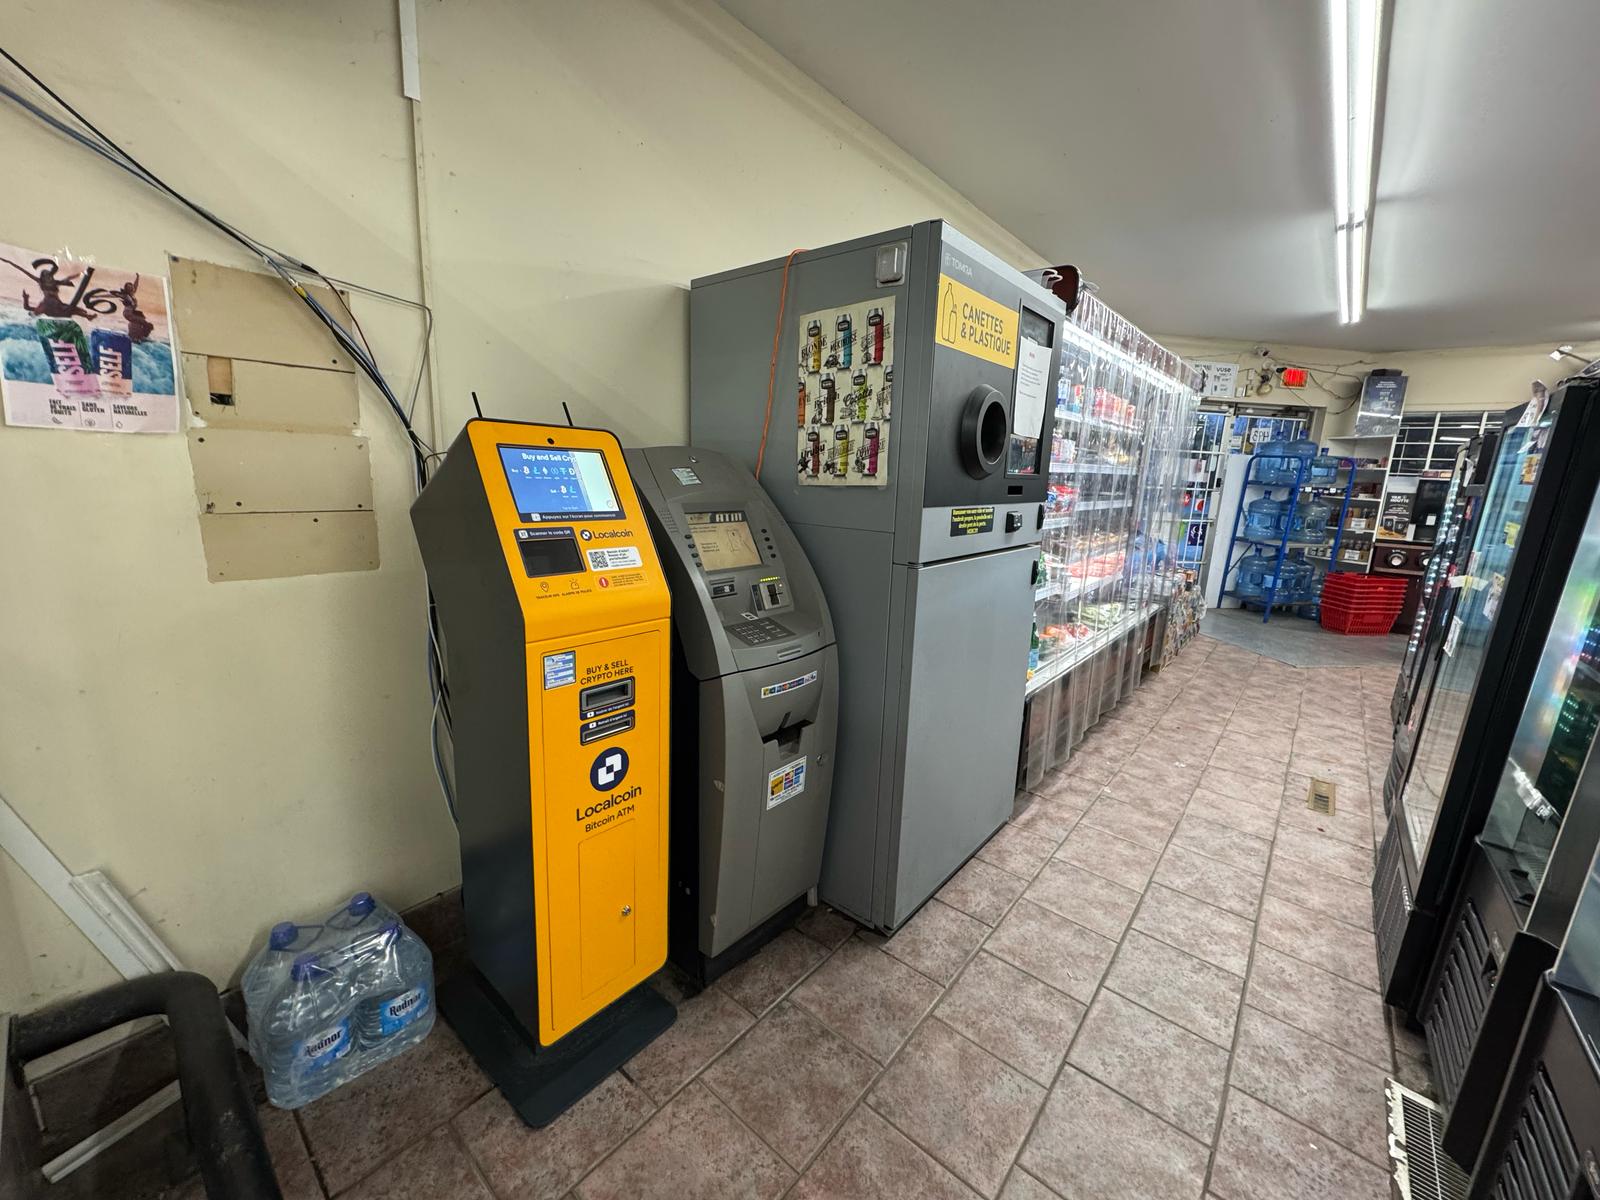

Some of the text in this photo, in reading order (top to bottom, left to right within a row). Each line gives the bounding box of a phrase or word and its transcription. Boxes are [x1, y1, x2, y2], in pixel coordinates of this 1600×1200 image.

[962, 303, 1003, 334] CANETTES
[960, 322, 1011, 356] & PLASTIQUE
[100, 344, 123, 379] SELF
[521, 453, 536, 462] Buy
[592, 529, 634, 539] Localcoin
[580, 666, 634, 685] CRYPTO HERE
[586, 666, 603, 675] BUY
[611, 659, 629, 669] SELL
[576, 786, 642, 821] Localcoin
[585, 804, 634, 832] Bitcoin ATM
